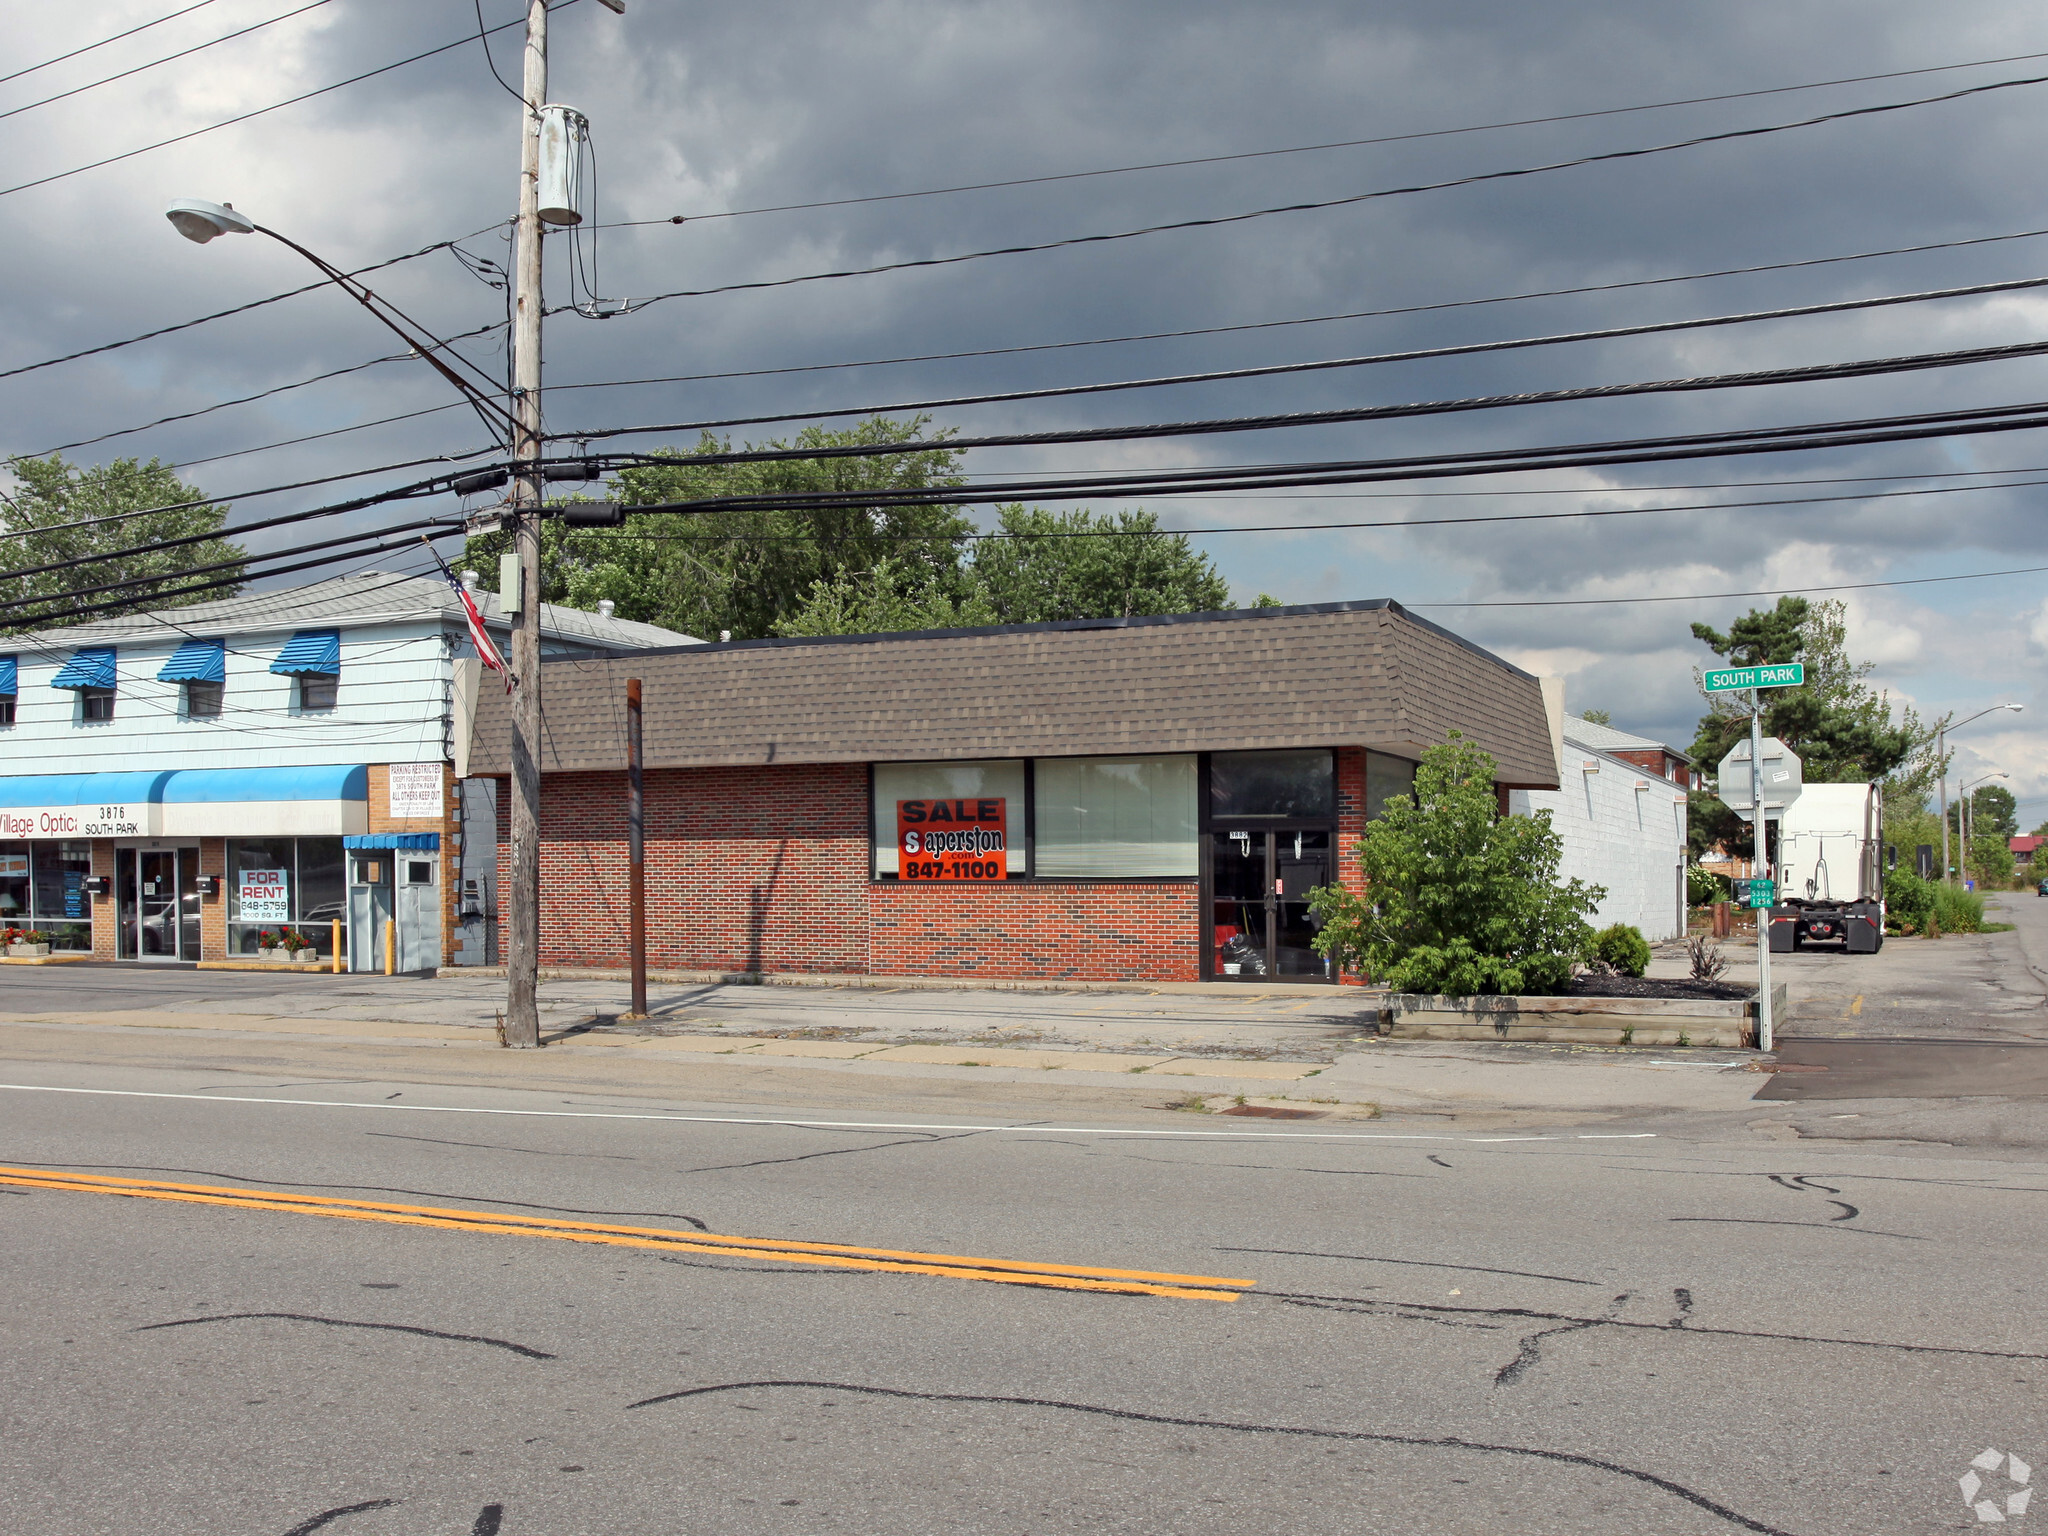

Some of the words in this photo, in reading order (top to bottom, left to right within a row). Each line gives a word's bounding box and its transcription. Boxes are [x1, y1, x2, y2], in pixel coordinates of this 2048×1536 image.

[1712, 671, 1755, 687] SOUTH
[1760, 668, 1795, 683] PARK
[391, 765, 411, 775] PARKING
[412, 764, 441, 774] RESTRICTED
[392, 791, 400, 800] ALL
[401, 791, 418, 800] OTHERS
[419, 791, 430, 800] KEEP
[431, 791, 440, 800] OUT
[99, 806, 125, 819] 3876
[902, 800, 1000, 823] SALE
[85, 823, 113, 835] SOUTH
[116, 823, 139, 834] PARK
[906, 861, 998, 879] 847-1100
[246, 872, 279, 884] FOR
[1756, 881, 1766, 889] 62
[242, 886, 284, 898] RENT
[241, 901, 287, 910] 648-5759
